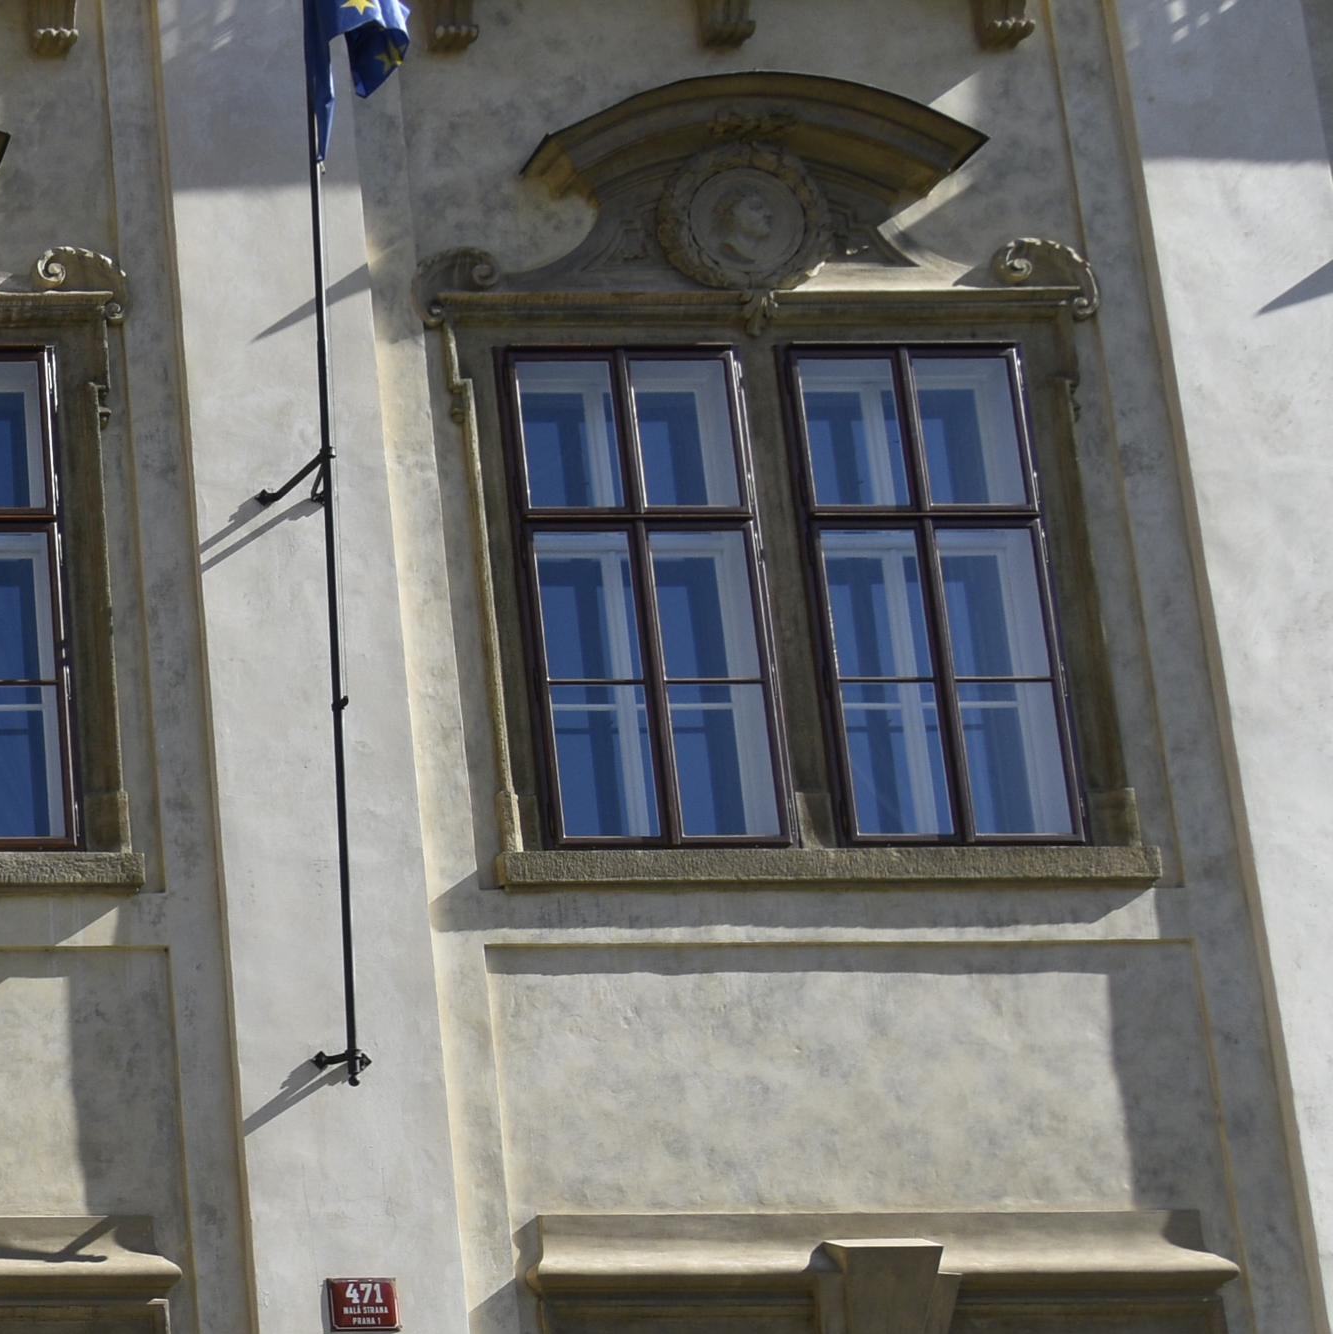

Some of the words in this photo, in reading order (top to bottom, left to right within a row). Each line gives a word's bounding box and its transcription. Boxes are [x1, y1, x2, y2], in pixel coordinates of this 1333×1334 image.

[345, 1283, 383, 1304] 471
[343, 1304, 362, 1315] MALÁ
[363, 1306, 389, 1314] STRANA
[352, 1317, 376, 1325] PRAHA
[377, 1317, 381, 1325] 1
